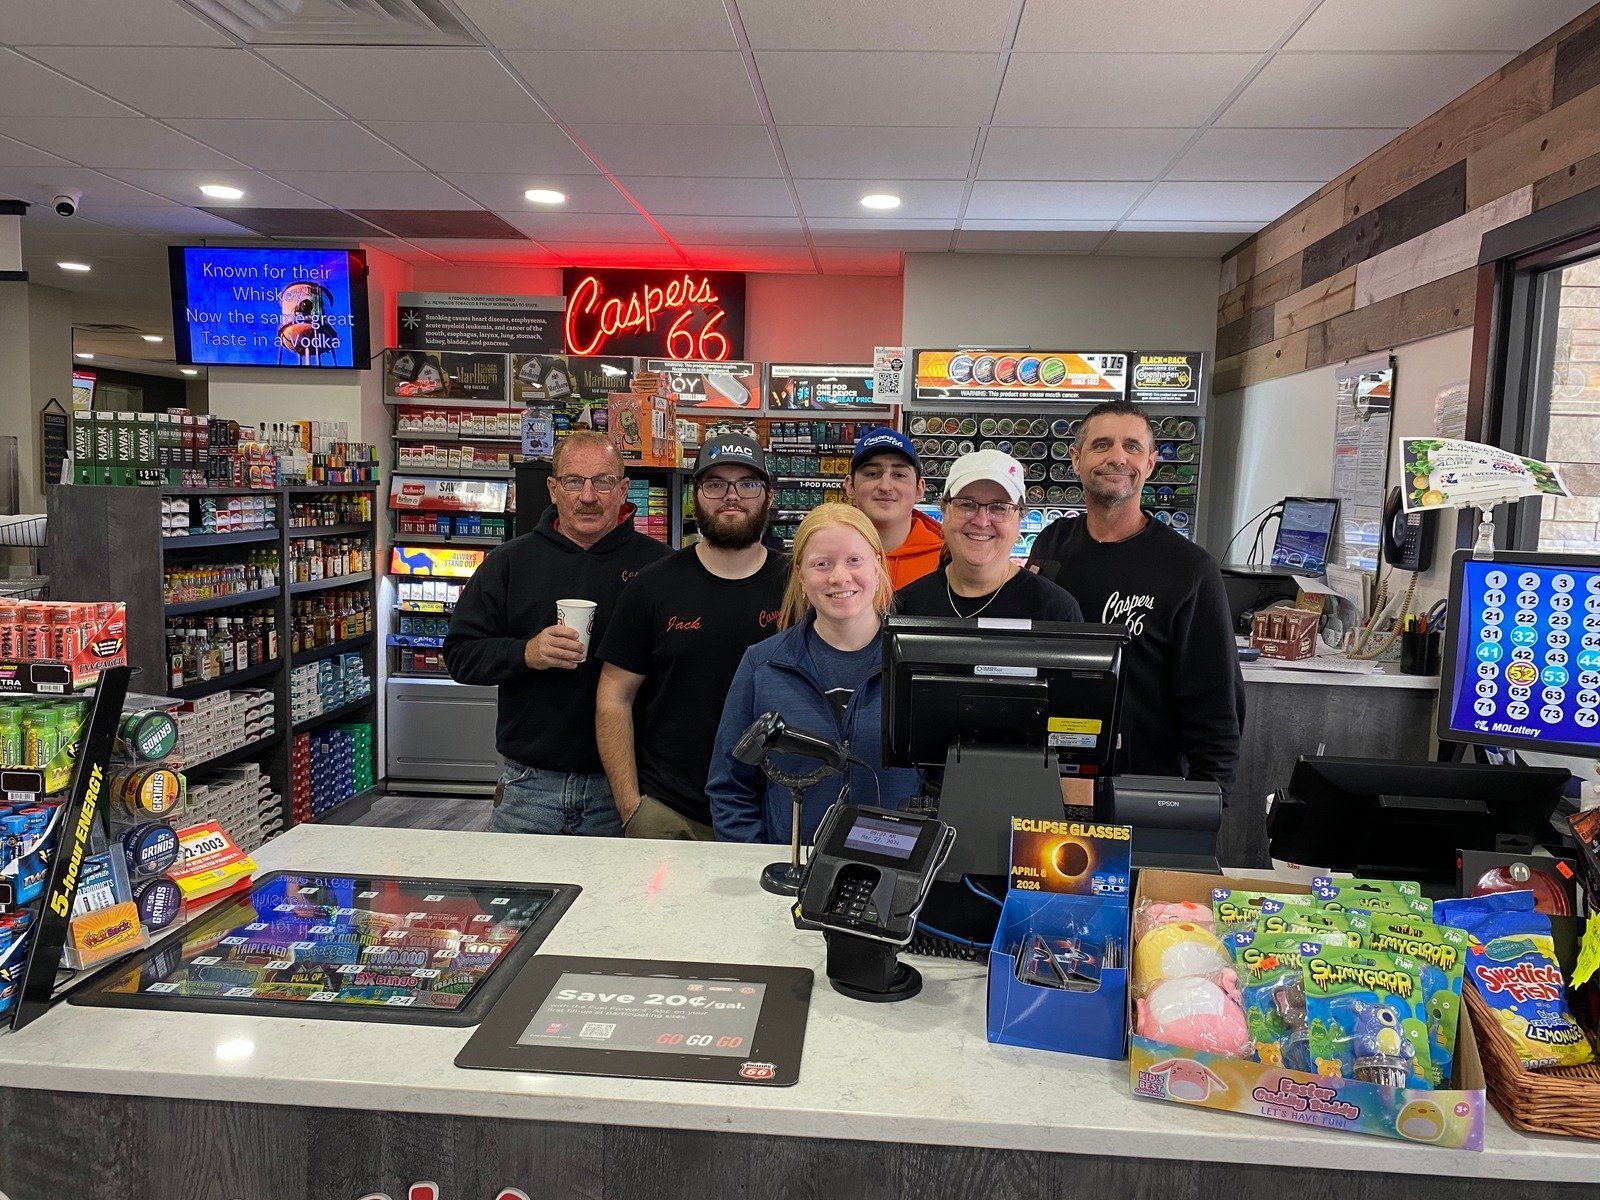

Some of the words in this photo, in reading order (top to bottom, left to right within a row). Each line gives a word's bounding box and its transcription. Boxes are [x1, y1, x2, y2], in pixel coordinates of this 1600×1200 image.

[203, 262, 258, 278] Known
[263, 263, 287, 279] for
[294, 264, 331, 280] their
[233, 286, 307, 303] Whiskey
[186, 308, 222, 323] Now
[227, 309, 255, 325] the
[260, 312, 306, 325] same
[310, 312, 355, 330] great
[425, 314, 451, 322] Smoking
[511, 317, 547, 325] emphysema,
[566, 274, 719, 355] Caspers
[441, 322, 465, 330] myeloid
[466, 323, 494, 331] leukemia,
[202, 331, 247, 347] Taste
[253, 332, 268, 347] in
[273, 336, 284, 347] a
[289, 333, 341, 349] Vodka
[425, 338, 446, 346] kidney,
[447, 331, 479, 339] esophagus,
[500, 332, 516, 340] lung,
[667, 310, 727, 361] 66
[1140, 356, 1163, 364] BLACK
[1168, 356, 1187, 364] BACK
[456, 363, 497, 384] Marlboro
[1137, 369, 1180, 381] Copenhagen
[996, 391, 1019, 399] product
[76, 426, 85, 459] KAYAK
[98, 427, 108, 460] KAYAK
[118, 427, 128, 461] KAYAK
[139, 428, 149, 461] KAYAK
[721, 445, 753, 456] MAC
[444, 560, 464, 568] STAND
[1525, 577, 1533, 586] 2
[1102, 591, 1154, 624] Caspers
[667, 616, 702, 632] Jack
[1125, 611, 1146, 635] 66
[413, 636, 437, 645] CAMEL
[1483, 629, 1500, 639] 31
[1513, 631, 1536, 644] 32
[1478, 647, 1498, 659] 41
[1514, 650, 1532, 660] 42
[1480, 665, 1496, 675] 51
[1509, 666, 1536, 681] 52
[1477, 702, 1493, 712] 71
[1510, 705, 1527, 715] 72
[1492, 723, 1541, 737] MOLottery
[143, 722, 172, 754] GRINDS
[153, 774, 164, 811] GRINDS
[1013, 818, 1068, 836] ECLIPSE
[1069, 824, 1131, 841] GLASSES
[51, 840, 85, 918] 5-hour
[78, 763, 103, 844] ENERGY
[142, 838, 174, 860] GRINDS
[1011, 865, 1040, 878] APRIL
[1016, 880, 1041, 891] 2024
[1314, 878, 1329, 887] 3+
[1321, 888, 1337, 898] 3+
[153, 886, 167, 924] GRINDS
[1410, 902, 1428, 912] FUN!
[1350, 918, 1367, 929] FUN!
[236, 944, 268, 956] TRIPLE
[271, 946, 287, 957] RED
[370, 950, 426, 965] $100,000
[1370, 932, 1458, 971] LIMYGLOOP
[343, 965, 360, 973] 19
[291, 972, 309, 982] FULL
[311, 972, 322, 982] OF
[354, 972, 377, 986] 5X
[376, 974, 418, 986] BINGO
[433, 976, 474, 990] TREASURE
[1476, 963, 1565, 994] Swedish
[152, 983, 173, 991] 21
[1504, 981, 1561, 1004] Fish
[392, 997, 410, 1005] 24
[556, 989, 636, 1004] Save
[606, 1010, 663, 1019] participating
[1539, 1009, 1560, 1020] blue
[656, 1033, 684, 1045] GO
[686, 1034, 714, 1046] GO
[715, 1036, 743, 1048] GO
[1527, 1025, 1583, 1045] LEMONADE
[1139, 1071, 1165, 1084] KID'S
[1139, 1080, 1163, 1092] BEST
[1280, 1078, 1335, 1100] Easter
[1255, 1089, 1307, 1110] Cuddly
[1309, 1099, 1359, 1119] Buddy
[1261, 1107, 1287, 1118] LET'S
[1291, 1112, 1318, 1124] HAVE
[1322, 1117, 1347, 1129] FUN!
